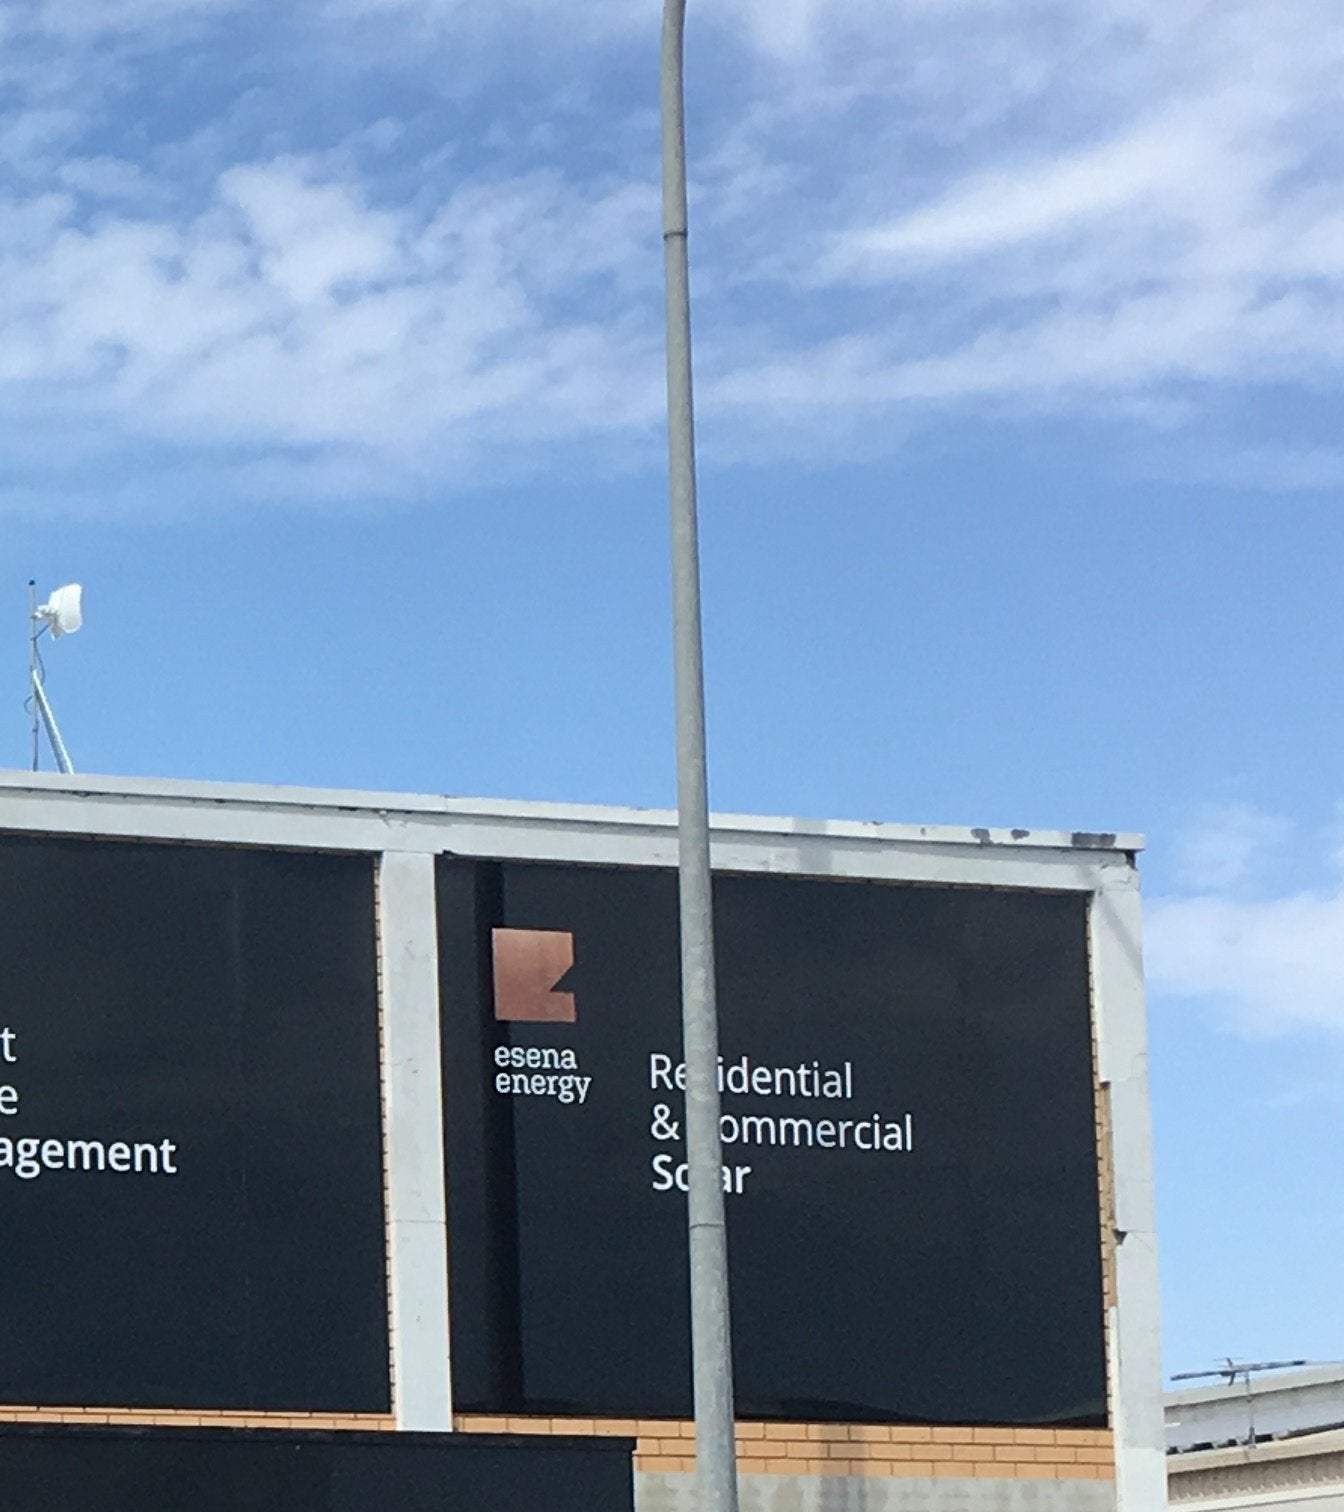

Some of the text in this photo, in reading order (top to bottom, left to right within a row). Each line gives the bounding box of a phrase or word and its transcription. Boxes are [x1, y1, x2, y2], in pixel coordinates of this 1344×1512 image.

[493, 1044, 578, 1070] esena
[649, 1053, 854, 1099] Reidential
[494, 1072, 592, 1104] energy
[650, 1103, 915, 1152] & ommercial
[651, 1153, 753, 1195] Soar
